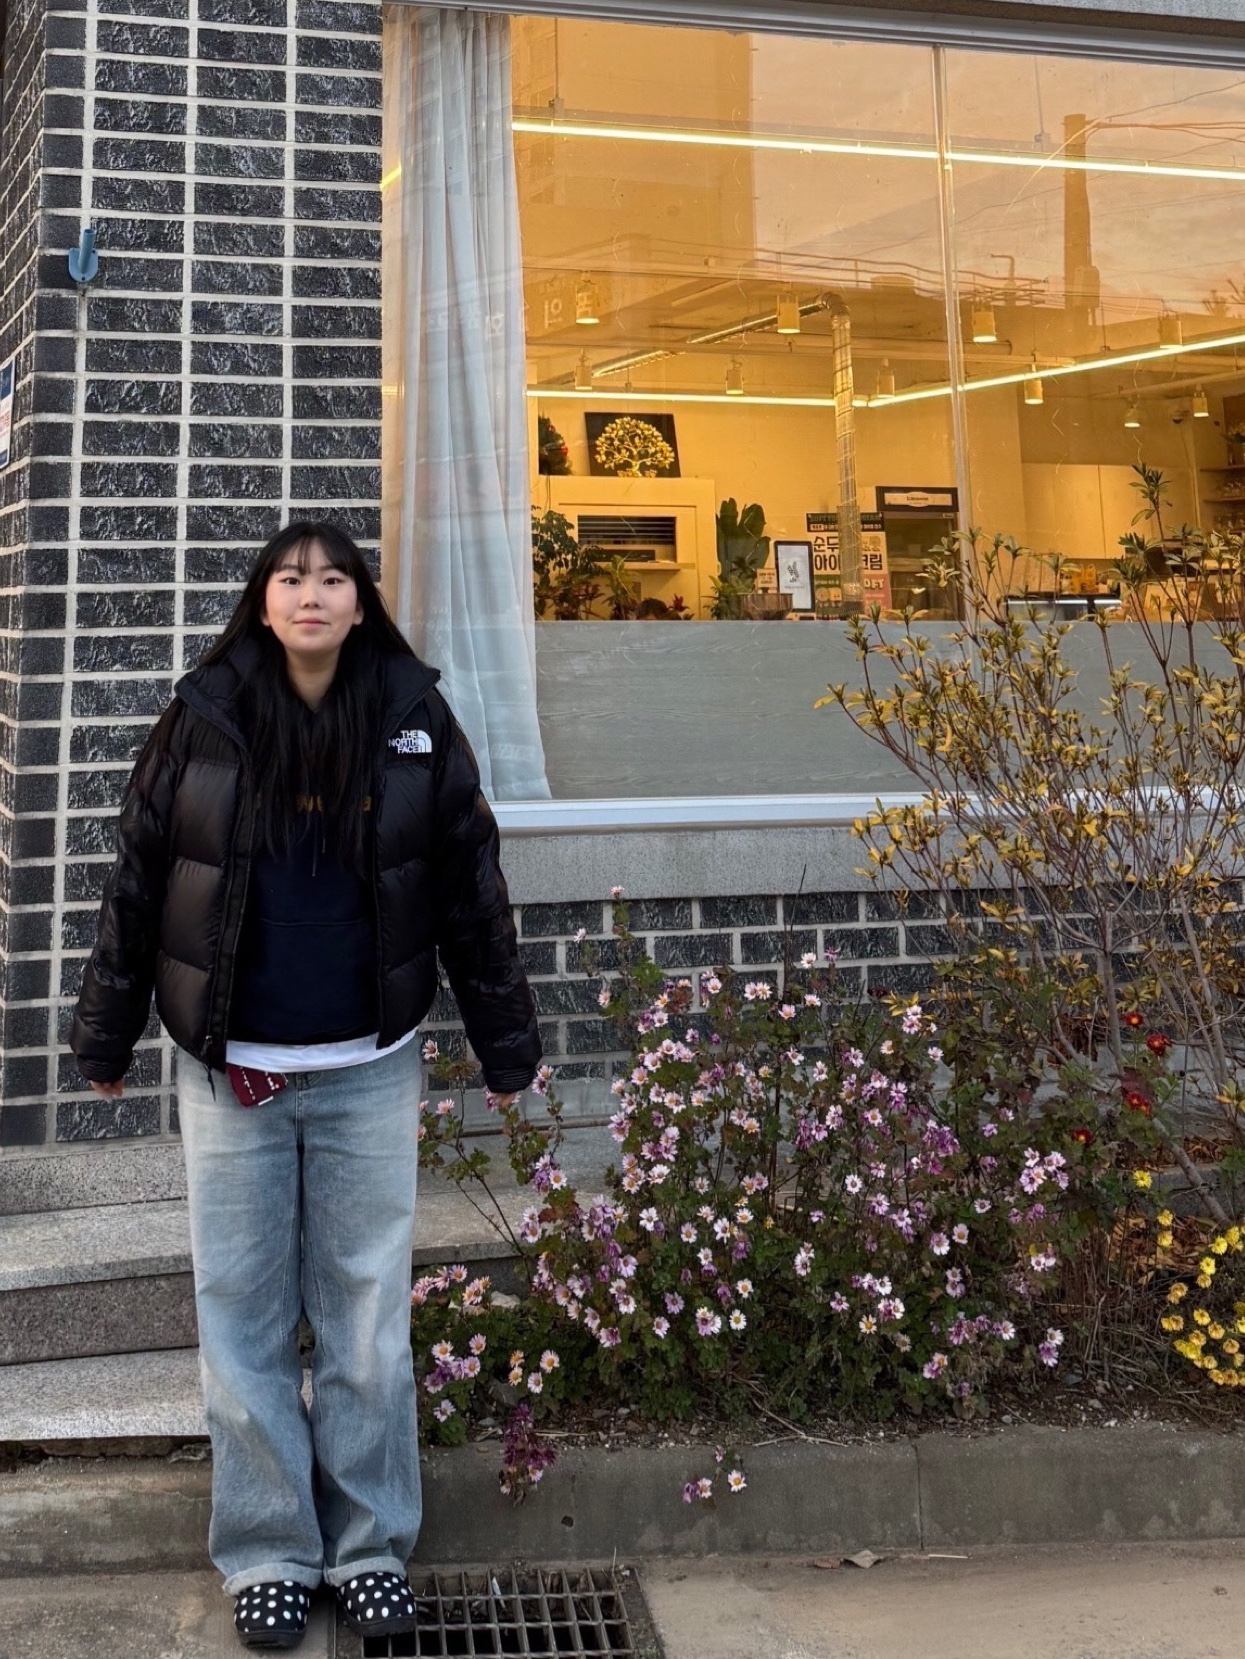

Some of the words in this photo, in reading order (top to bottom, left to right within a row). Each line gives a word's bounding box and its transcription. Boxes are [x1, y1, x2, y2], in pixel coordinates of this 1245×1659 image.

[813, 536, 840, 553] 순두
[400, 730, 418, 738] THE
[388, 738, 417, 748] NORTH
[397, 746, 418, 754] FACE
